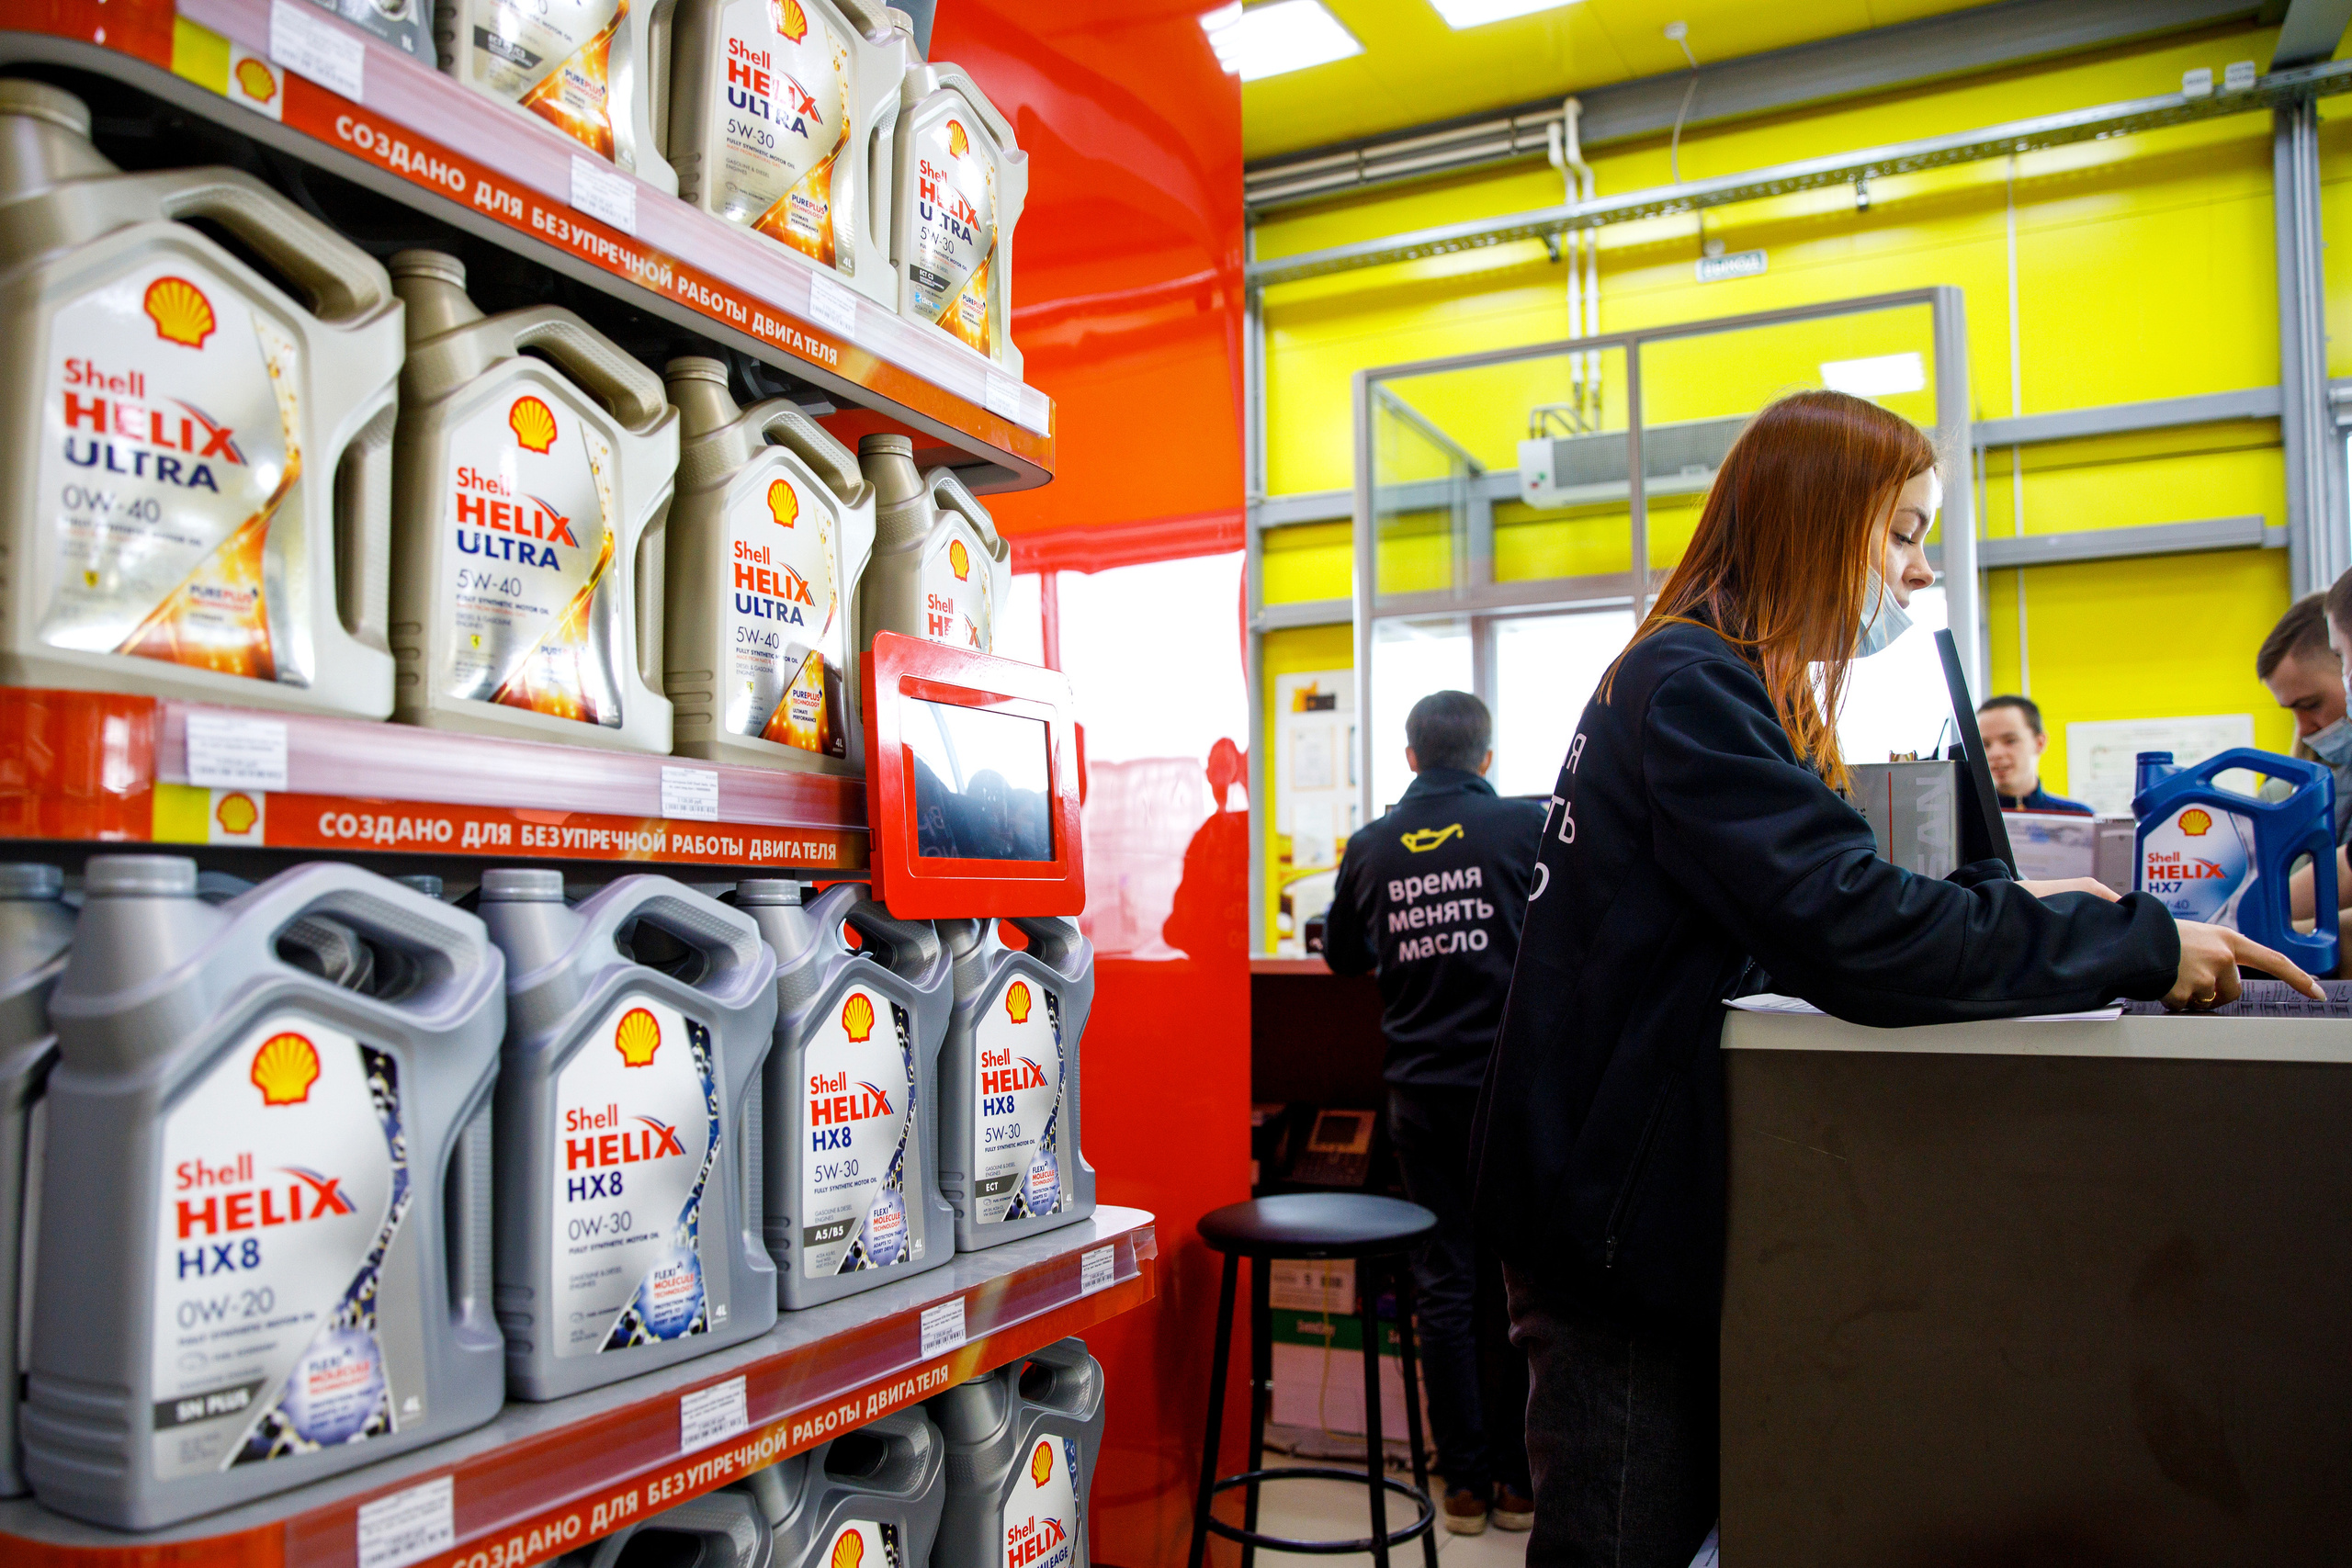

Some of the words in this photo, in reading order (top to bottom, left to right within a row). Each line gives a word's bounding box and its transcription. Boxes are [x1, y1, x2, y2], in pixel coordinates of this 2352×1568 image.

[728, 38, 771, 71] Shell
[564, 69, 603, 97] PUREPLUS
[727, 57, 822, 125] HELIX
[728, 86, 808, 139] ULTRA
[726, 118, 775, 149] 5W-30
[726, 137, 741, 147] FULLY
[742, 142, 769, 157] SYNTHETIC
[770, 153, 787, 165] MOTOR
[787, 162, 796, 170] OIL
[726, 157, 751, 171] GASOLINE
[755, 167, 770, 178] DIESEL
[726, 164, 747, 176] ENGINES
[791, 194, 825, 215] PUREPLUS
[791, 202, 823, 220] TECHNOLOGY
[791, 212, 809, 223] ULTIMATE
[791, 218, 820, 233] PERFORMANCE
[920, 201, 973, 246] UTRA
[335, 115, 467, 192] СОЗДАНО
[474, 180, 524, 220] ДЛЯ
[532, 206, 673, 290] БЕЗУПРЕЧНОЙ
[678, 279, 747, 324] РАБОТЫ
[752, 311, 838, 367] ДВИГАТЕЛЯ
[920, 226, 955, 254] 5W-30
[842, 257, 853, 268] 4L
[962, 294, 985, 310] PUREPLUS
[64, 357, 145, 399] Shell
[62, 391, 245, 466] HELIX
[64, 436, 220, 494] ULTRA
[457, 467, 511, 497] Shell
[62, 483, 162, 525] 0W-40
[456, 492, 579, 548] HELIX
[458, 529, 560, 571] ULTRA
[734, 540, 770, 565] Shell
[457, 569, 522, 597] 5W-40
[733, 560, 815, 607] HELIX
[735, 592, 804, 626] ULTRA
[928, 593, 954, 615] Shell
[736, 626, 779, 649] 5W-40
[928, 613, 981, 649] HEX
[736, 647, 750, 655] FULLY
[751, 649, 774, 660] SYNTHETIC
[736, 669, 755, 677] ENGINES
[754, 665, 775, 673] GASOLINE
[792, 689, 820, 702] PUREPLUS
[793, 698, 820, 708] TECHNOLOGY
[792, 715, 817, 723] PERFORMANCE
[835, 738, 843, 748] 4L
[319, 812, 453, 845] СОЗДАНО
[461, 820, 512, 849] ДЛЯ
[521, 825, 666, 854] БЕЗУПРЕЧНОЙ
[672, 832, 743, 857] РАБОТЫ
[750, 839, 836, 862] ДВИГАТЕЛЯ
[2148, 852, 2180, 863] Shell
[2147, 858, 2227, 880] HELIX
[1388, 866, 1482, 904] время
[2148, 882, 2183, 893] HX7
[1388, 898, 1495, 933] менять
[1399, 929, 1488, 963] масло
[981, 1048, 1011, 1068] Shell
[810, 1071, 847, 1095] Shell
[981, 1055, 1048, 1095] HELIX
[809, 1080, 894, 1127] HELIX
[983, 1095, 1015, 1117] HX8
[566, 1103, 618, 1133] Shell
[565, 1114, 686, 1171] HELIX
[812, 1126, 852, 1153] HX8
[985, 1122, 1021, 1144] 5W-30
[997, 1143, 1016, 1151] SYNTHETIC
[175, 1153, 254, 1191] Shell
[814, 1158, 859, 1183] 5W-30
[985, 1163, 1002, 1172] GASOLINE
[1032, 1165, 1046, 1174] FLEXI
[1032, 1169, 1055, 1180] MOLECULE
[568, 1170, 623, 1202] HX8
[814, 1187, 828, 1195] FULLY
[829, 1182, 854, 1192] SYNTHETIC
[854, 1179, 870, 1188] MOTOR
[986, 1181, 999, 1192] ECT
[1032, 1178, 1055, 1187] TECHNOLOGY
[175, 1165, 357, 1240] HELIX
[814, 1207, 836, 1217] GASOLINE
[841, 1203, 853, 1212] DIESEL
[874, 1208, 888, 1218] FLEXI
[568, 1210, 632, 1241] 0W-30
[815, 1214, 834, 1224] ENGINES
[873, 1211, 900, 1225] MOLECULE
[874, 1220, 900, 1233] TECHNOLOGY
[815, 1225, 843, 1241] A5/B5
[874, 1233, 894, 1242] PROTECTION
[874, 1240, 887, 1248] ADAPTS
[914, 1237, 922, 1249] 4L
[177, 1237, 261, 1280] HX8
[874, 1247, 884, 1256] EVERY
[884, 1244, 894, 1252] DRIVE
[653, 1273, 695, 1290] MOLECULE
[654, 1269, 675, 1280] FLEXI
[653, 1283, 694, 1299] TECHNOLOGY
[176, 1286, 275, 1329] 0W-20
[715, 1304, 728, 1317] 4L
[590, 1490, 639, 1535] ДЛЯ
[648, 1425, 787, 1506] БЕЗУПРЕЧНОЙ
[793, 1400, 860, 1446] РАБОТЫ
[865, 1364, 948, 1419] ДВИГАТЕЛЯ
[1008, 1515, 1035, 1546] Shell
[1007, 1517, 1068, 1568] HELIX
